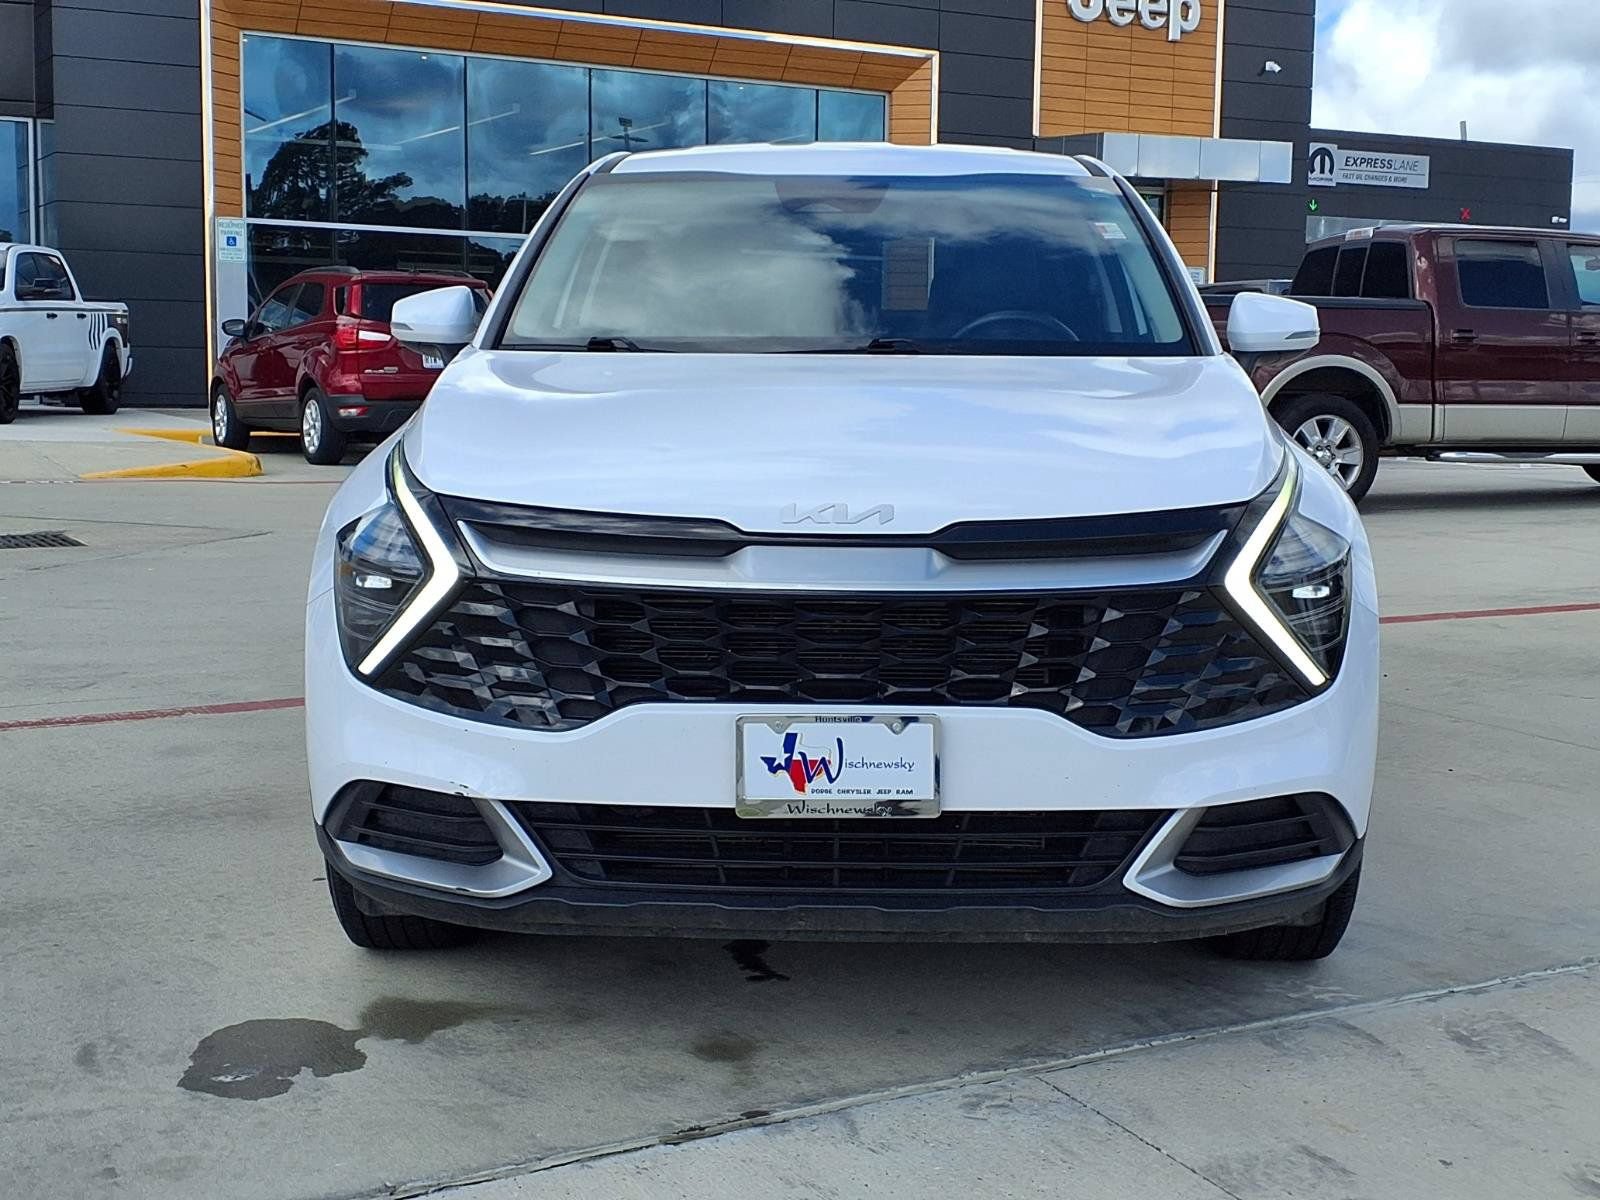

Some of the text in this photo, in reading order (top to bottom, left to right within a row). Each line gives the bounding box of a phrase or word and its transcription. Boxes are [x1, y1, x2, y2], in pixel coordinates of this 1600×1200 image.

[815, 715, 862, 723] Huntsville
[798, 737, 915, 784] Wischnewsky
[787, 799, 893, 817] Wischnewsky
